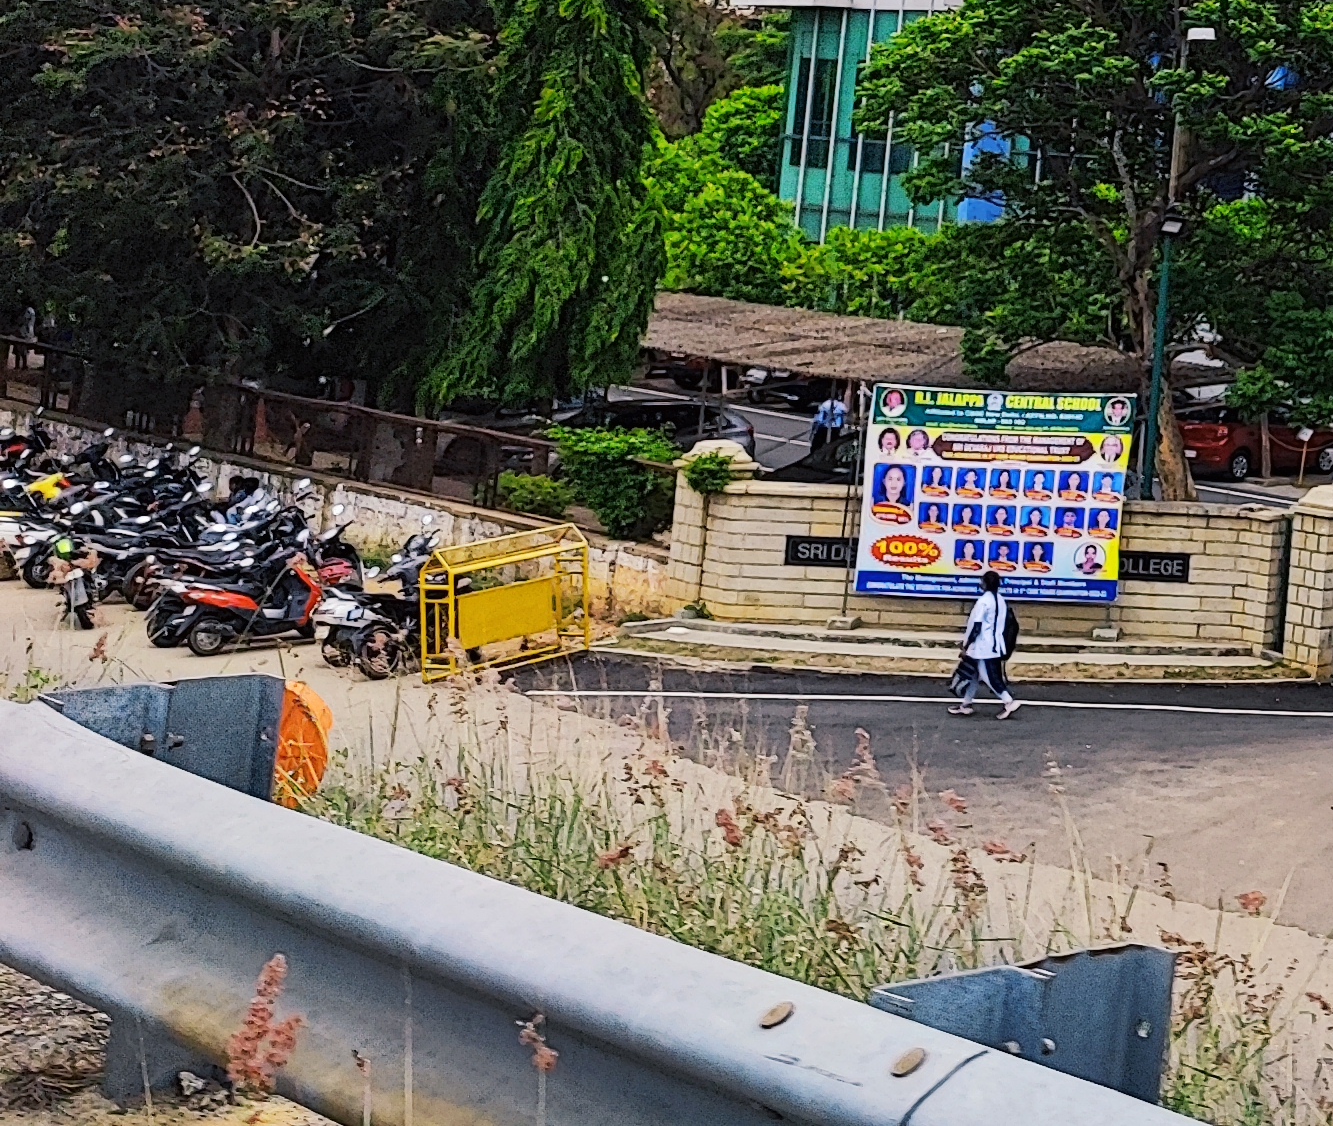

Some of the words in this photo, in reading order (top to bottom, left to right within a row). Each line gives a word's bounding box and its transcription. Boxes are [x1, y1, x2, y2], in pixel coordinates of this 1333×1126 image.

[1005, 394, 1055, 411] CENTRAL
[1056, 396, 1102, 412] SCHOOL
[797, 543, 828, 560] SRI
[876, 539, 939, 557] 100%
[1119, 557, 1184, 576] OLLEGE
